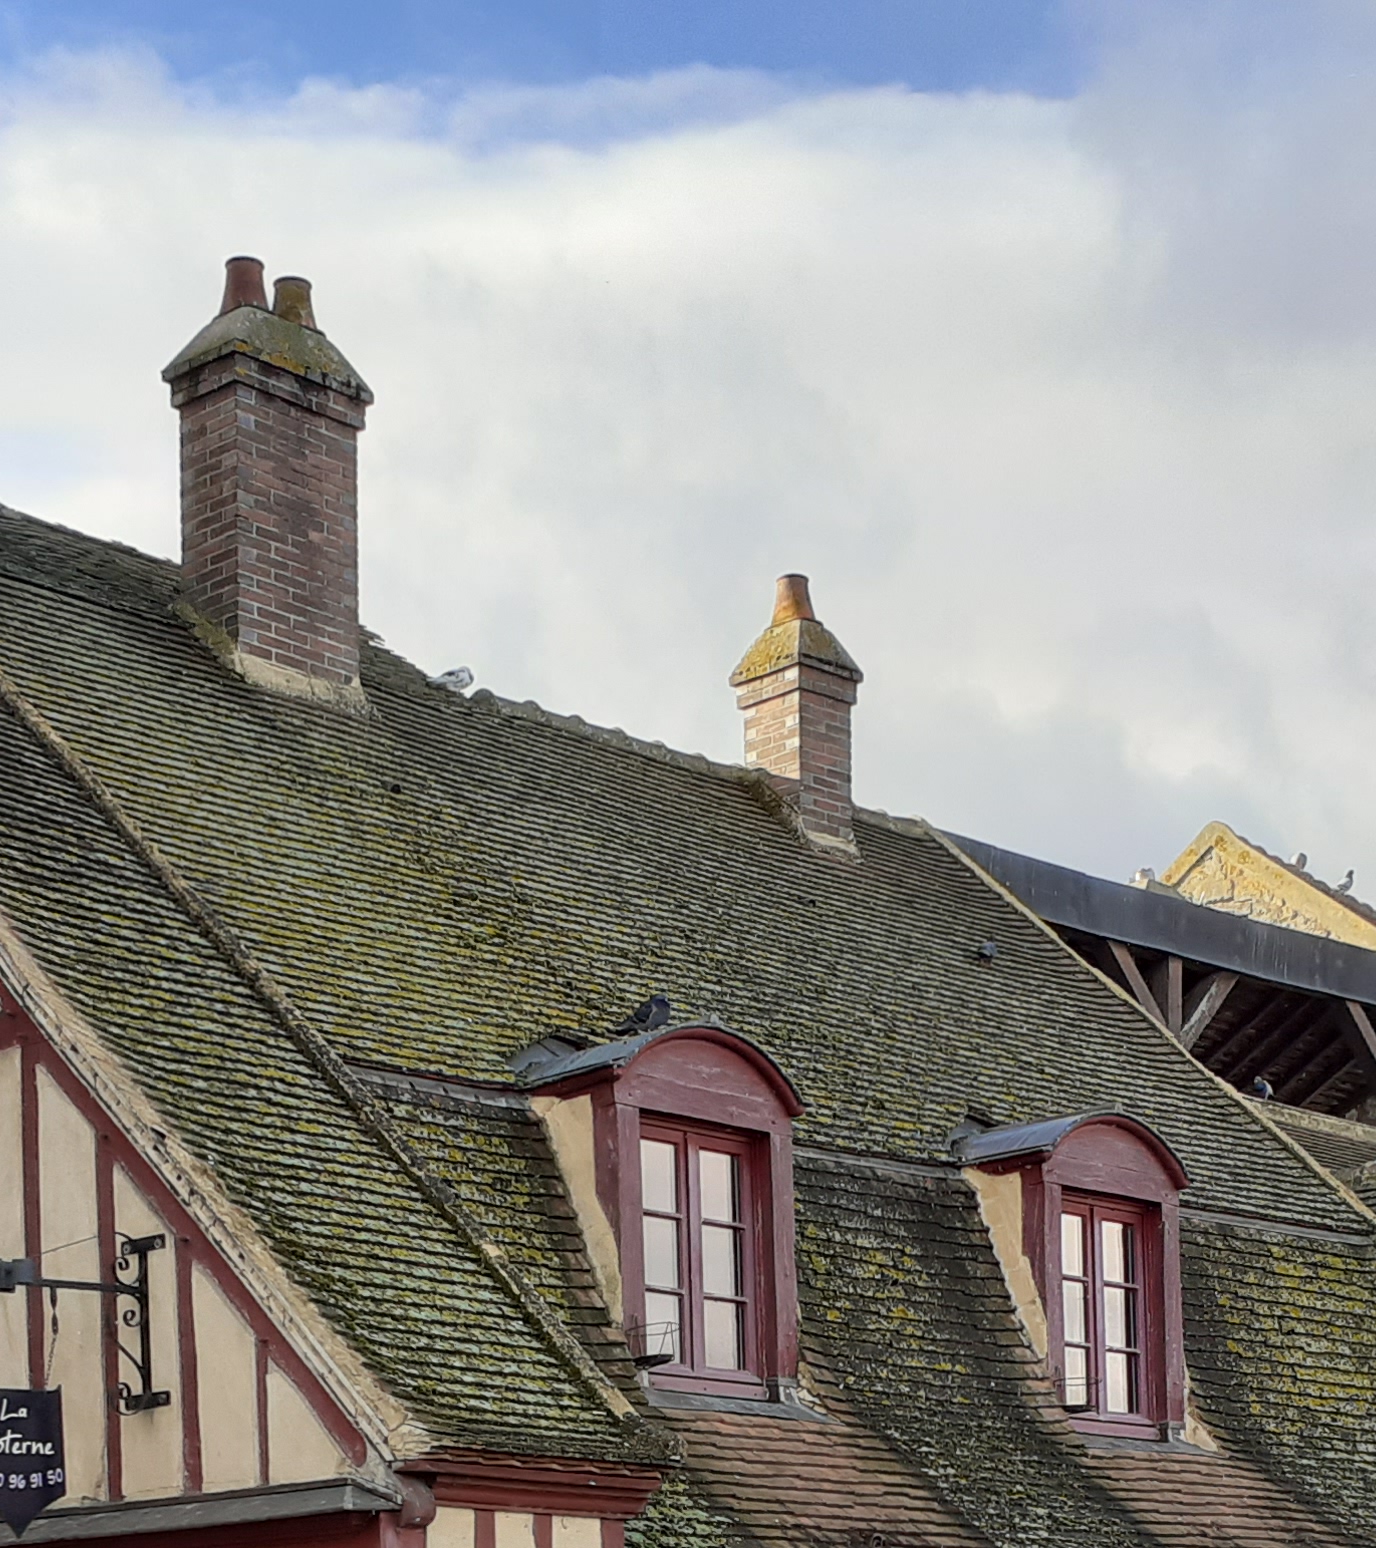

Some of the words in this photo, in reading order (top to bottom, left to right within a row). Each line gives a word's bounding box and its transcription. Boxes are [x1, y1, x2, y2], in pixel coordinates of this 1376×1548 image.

[0, 1398, 28, 1421] La
[8, 1473, 26, 1489] 96
[29, 1472, 43, 1488] 91
[46, 1467, 64, 1485] 50
